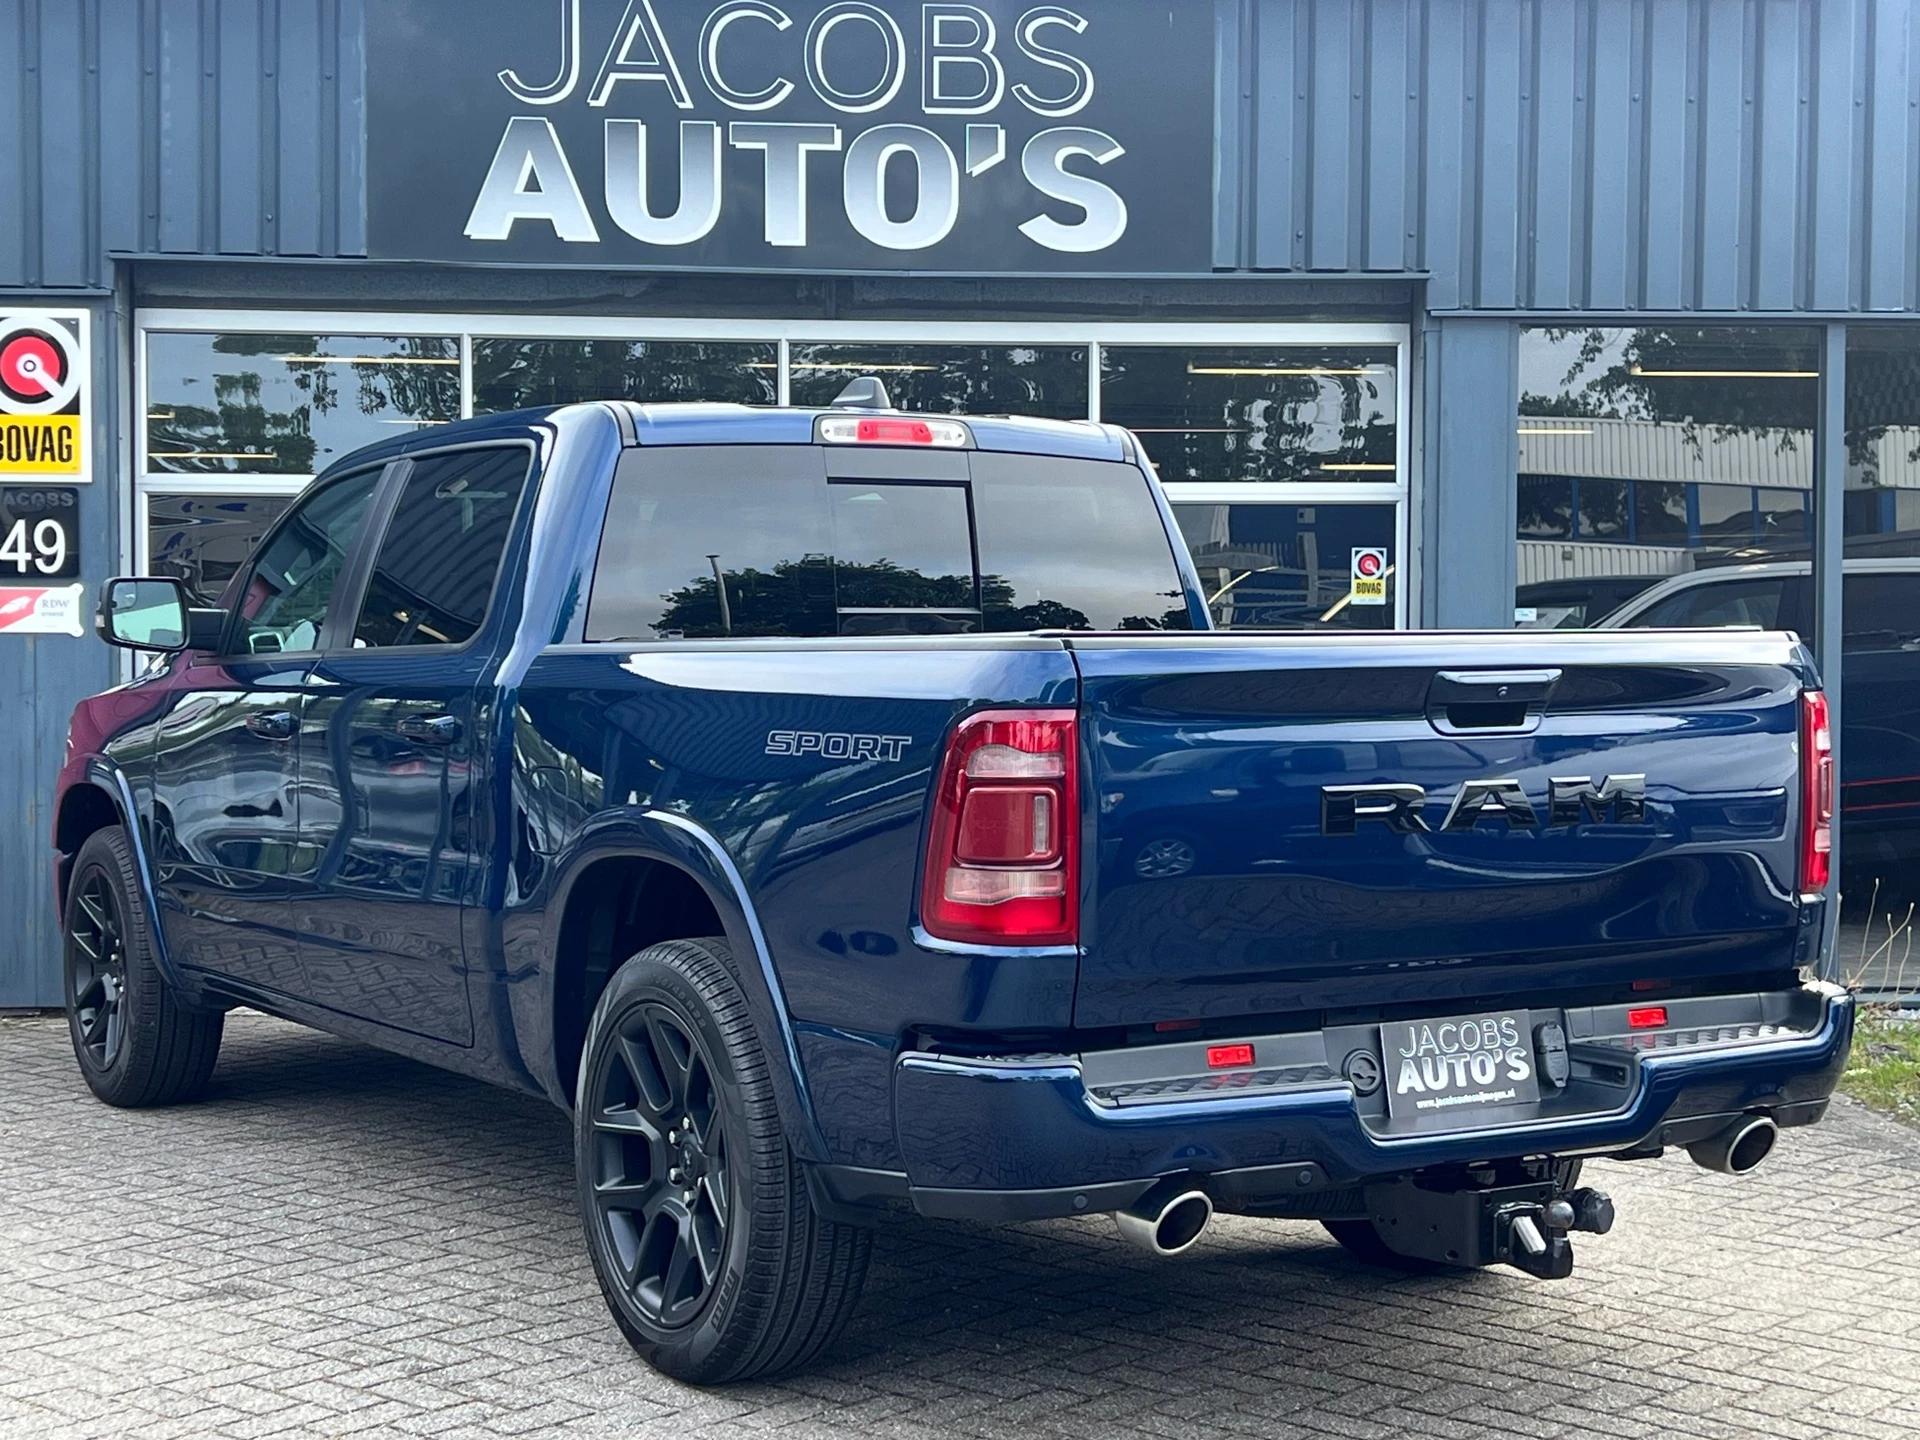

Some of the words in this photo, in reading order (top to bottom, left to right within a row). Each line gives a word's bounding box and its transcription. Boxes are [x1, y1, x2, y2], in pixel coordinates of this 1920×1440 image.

[497, 0, 1095, 117] JACOBS
[463, 116, 1128, 252] AUTO'S
[0, 425, 73, 463] OVAG
[1, 491, 75, 507] ACOBS
[0, 519, 66, 574] 49
[41, 598, 71, 609] RDW
[1356, 582, 1382, 595] BOVAG
[765, 730, 913, 762] SPORT
[1321, 773, 1646, 837] RAM
[1399, 1017, 1519, 1058] JACOBS
[1397, 1047, 1531, 1095] AUTO'S
[711, 1266, 741, 1335] PIRELLI
